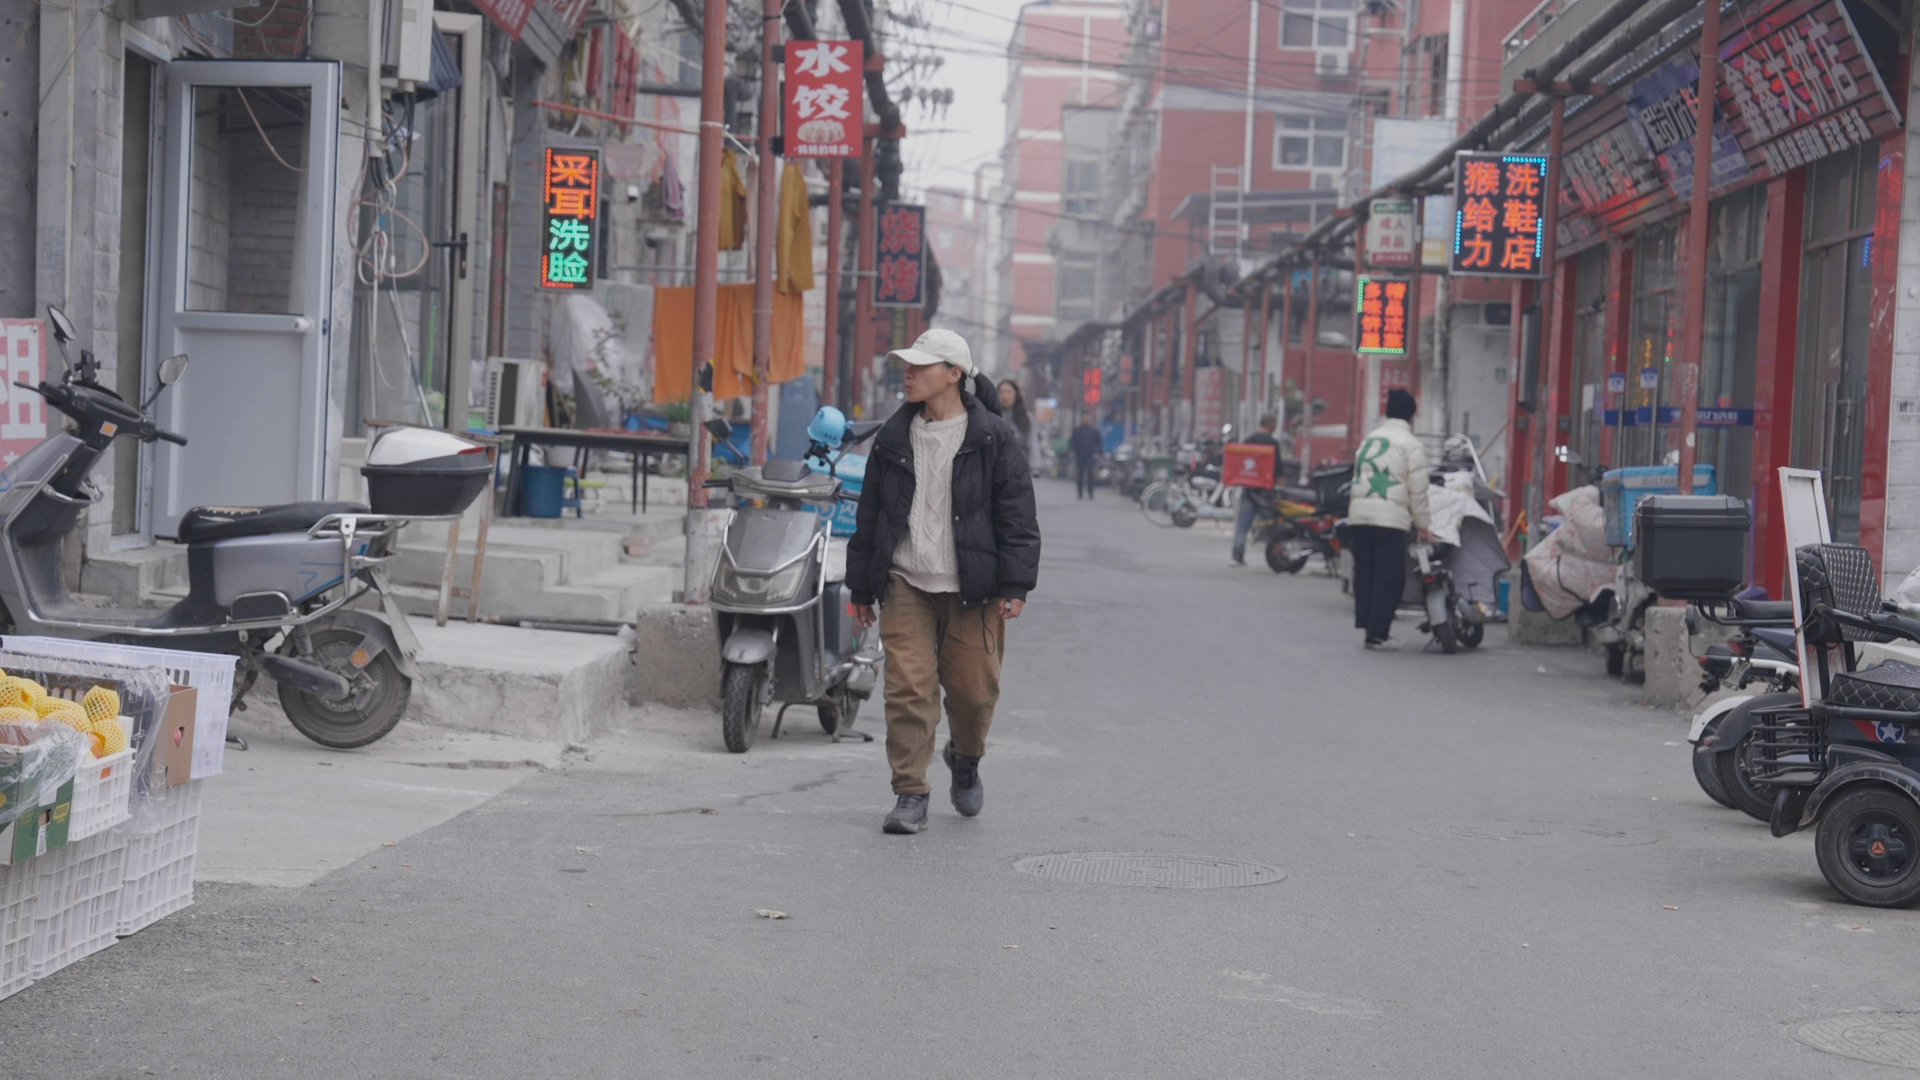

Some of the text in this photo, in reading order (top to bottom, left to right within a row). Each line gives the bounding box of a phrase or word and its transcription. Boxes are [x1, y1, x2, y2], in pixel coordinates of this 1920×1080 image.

[792, 42, 852, 119] 水饺
[549, 154, 590, 283] 采耳洗脸
[879, 207, 921, 301] 烧烤
[1461, 161, 1501, 268] 猴给力
[1501, 163, 1540, 270] 洗鞋店
[1352, 437, 1390, 484] R
